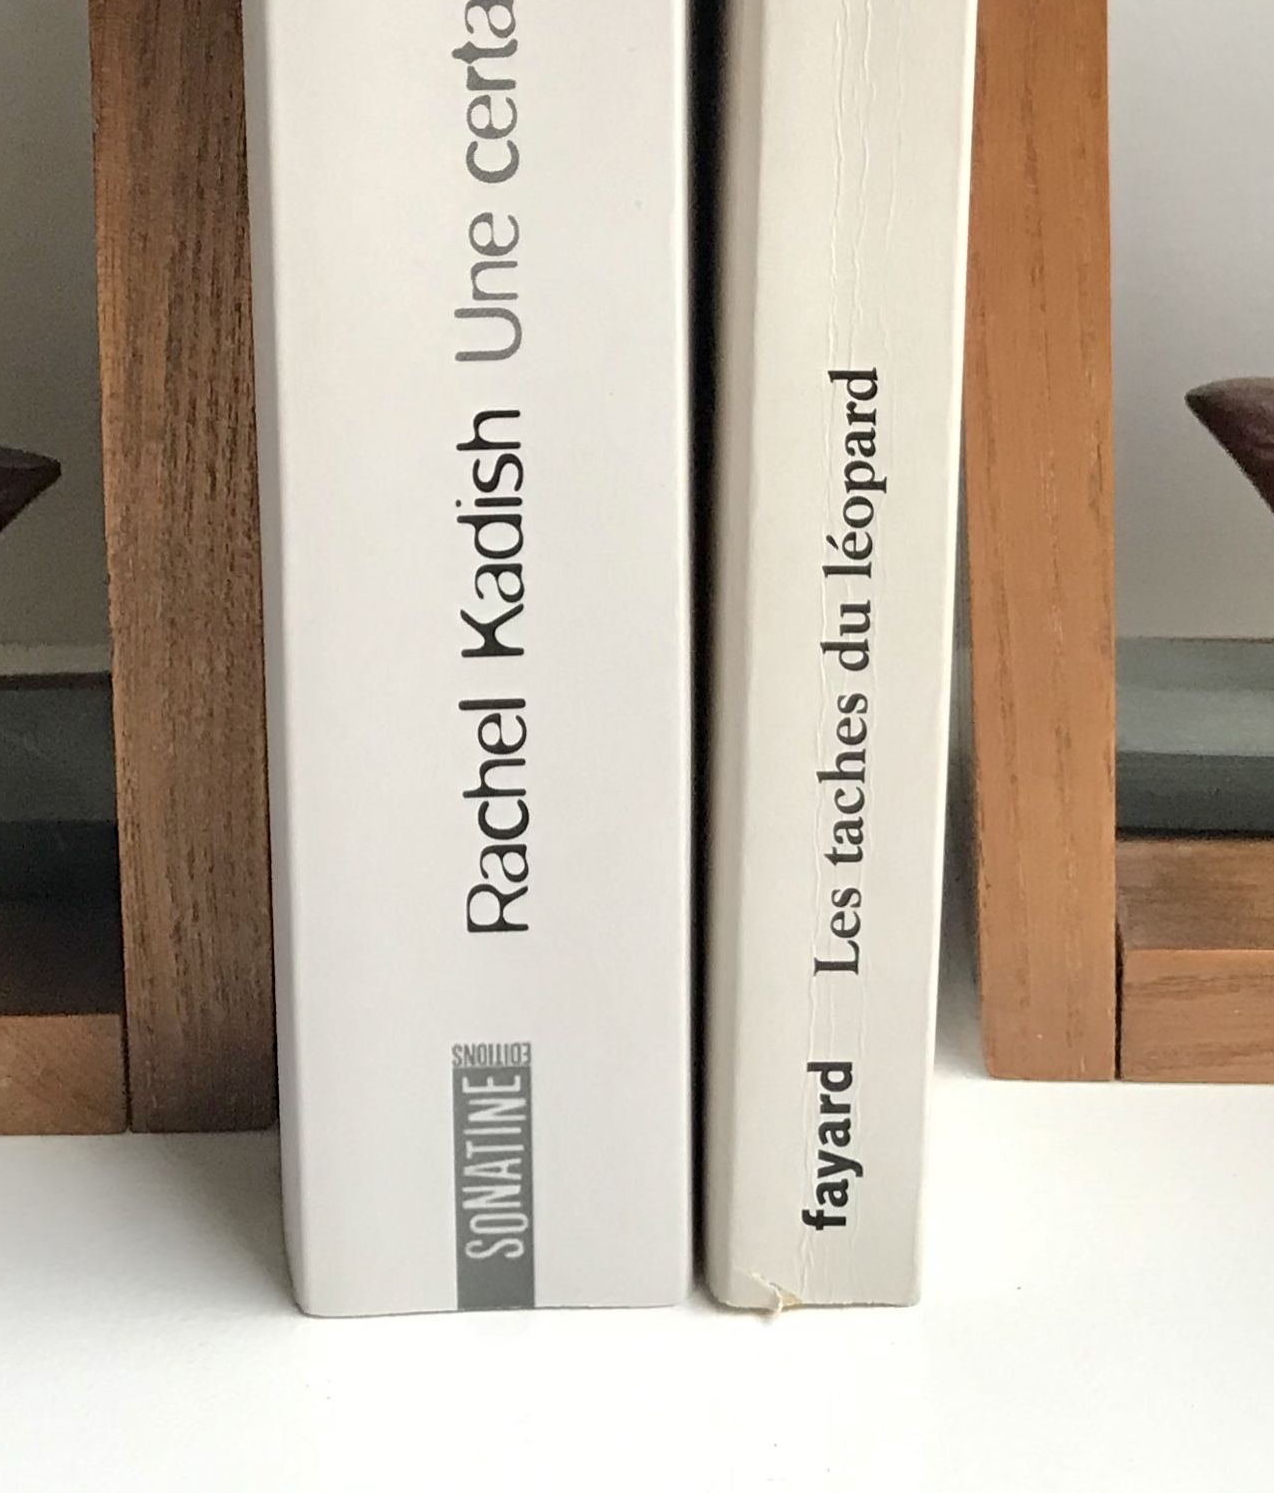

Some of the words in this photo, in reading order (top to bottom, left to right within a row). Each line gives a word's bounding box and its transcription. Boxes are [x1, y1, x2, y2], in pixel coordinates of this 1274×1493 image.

[454, 212, 523, 362] Une
[453, 409, 526, 659] Kadish
[822, 367, 888, 579] léopard
[820, 600, 871, 672] du
[458, 698, 530, 934] Rachel
[816, 693, 868, 866] taches
[813, 887, 862, 975] Les
[451, 1042, 532, 1067] EDITIONS
[461, 1074, 530, 1259] SONATINE
[801, 1061, 864, 1231] fayard
